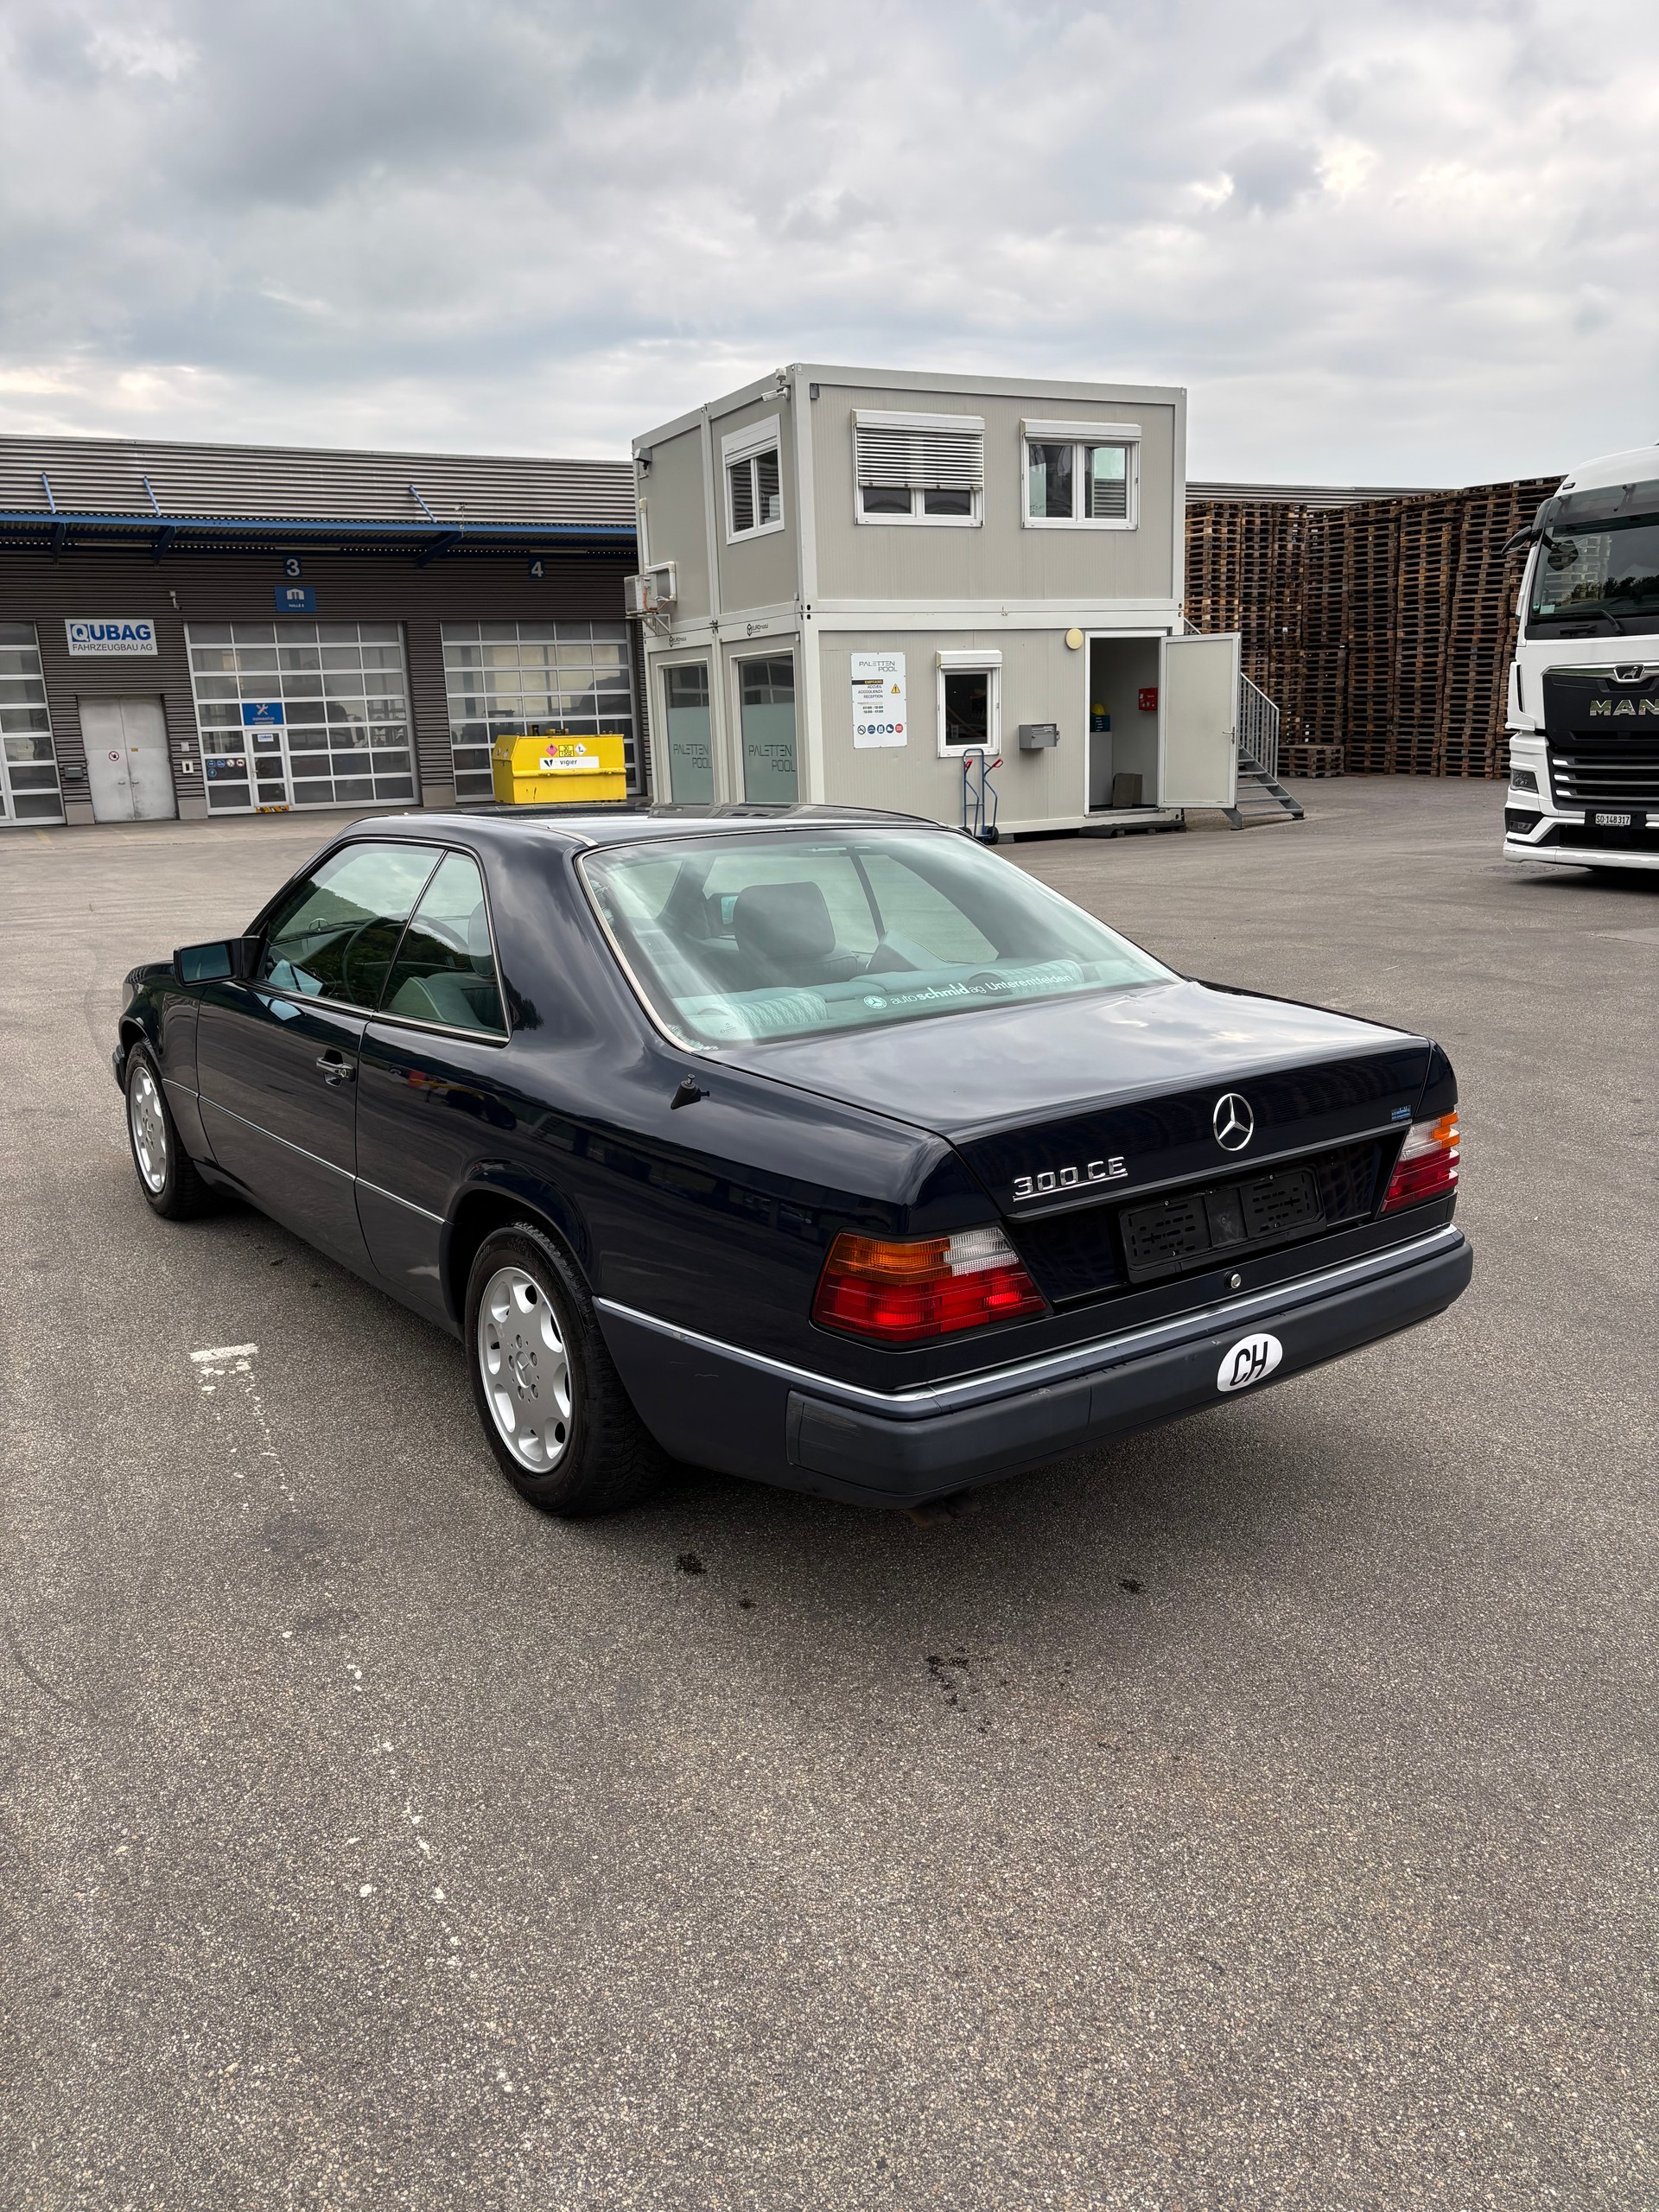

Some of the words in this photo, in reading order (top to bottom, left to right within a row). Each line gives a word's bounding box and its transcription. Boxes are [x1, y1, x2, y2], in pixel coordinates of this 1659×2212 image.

[286, 558, 300, 576] 3
[531, 561, 543, 577] 4
[69, 623, 151, 642] QUBAG
[72, 643, 138, 652] FAHRZEUGBAU
[1590, 698, 1659, 716] MAN
[673, 743, 709, 755] PALETTEN
[748, 744, 792, 757] PALETTEN
[692, 757, 713, 769] POOL
[771, 760, 797, 772] POOL
[987, 974, 1073, 991] Unterentfelden
[1014, 1166, 1078, 1197] 300
[1087, 1156, 1127, 1180] CE
[1230, 1341, 1268, 1386] CH
